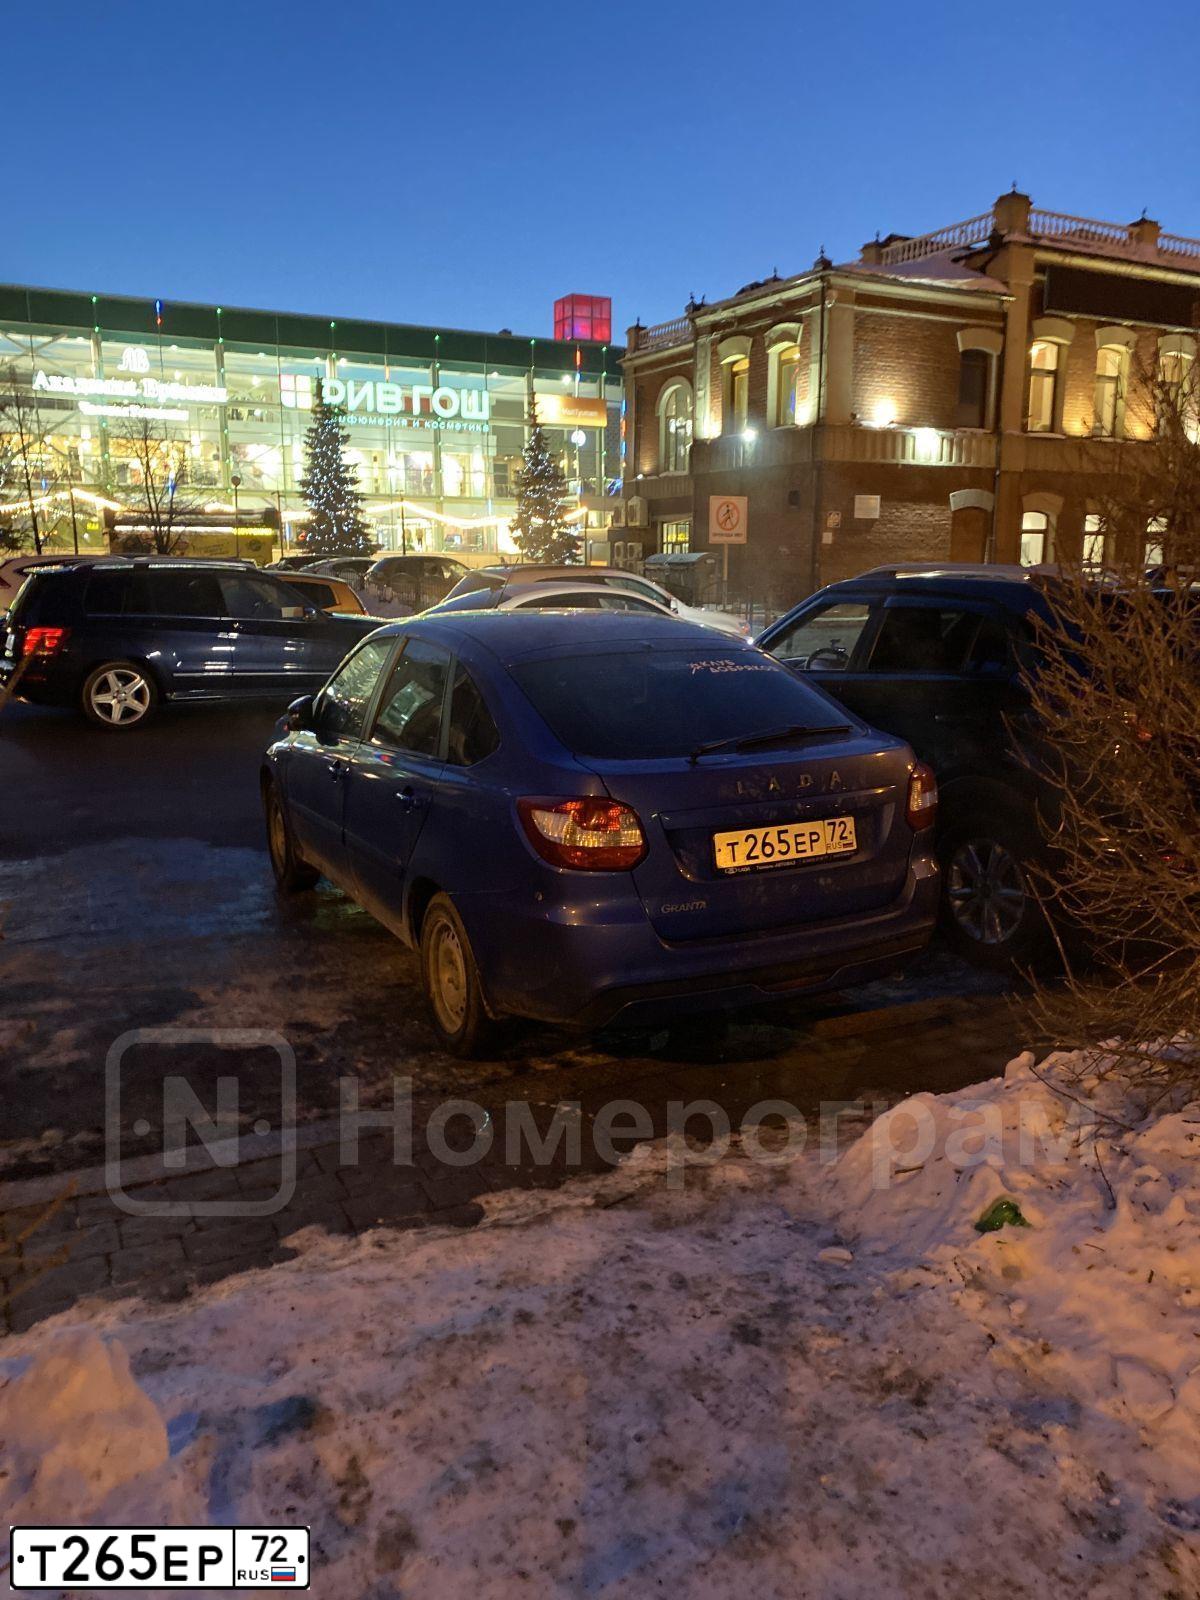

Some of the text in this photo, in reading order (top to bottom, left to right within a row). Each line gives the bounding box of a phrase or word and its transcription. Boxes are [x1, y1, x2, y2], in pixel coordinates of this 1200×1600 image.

[321, 378, 490, 420] РИВ ГОШ
[322, 414, 490, 433] фюмерия и косметика
[735, 769, 842, 795] LADA
[726, 829, 821, 862] Т265ЕР
[827, 821, 848, 842] 72
[826, 841, 842, 850] RUS
[660, 900, 707, 914] GRANTA
